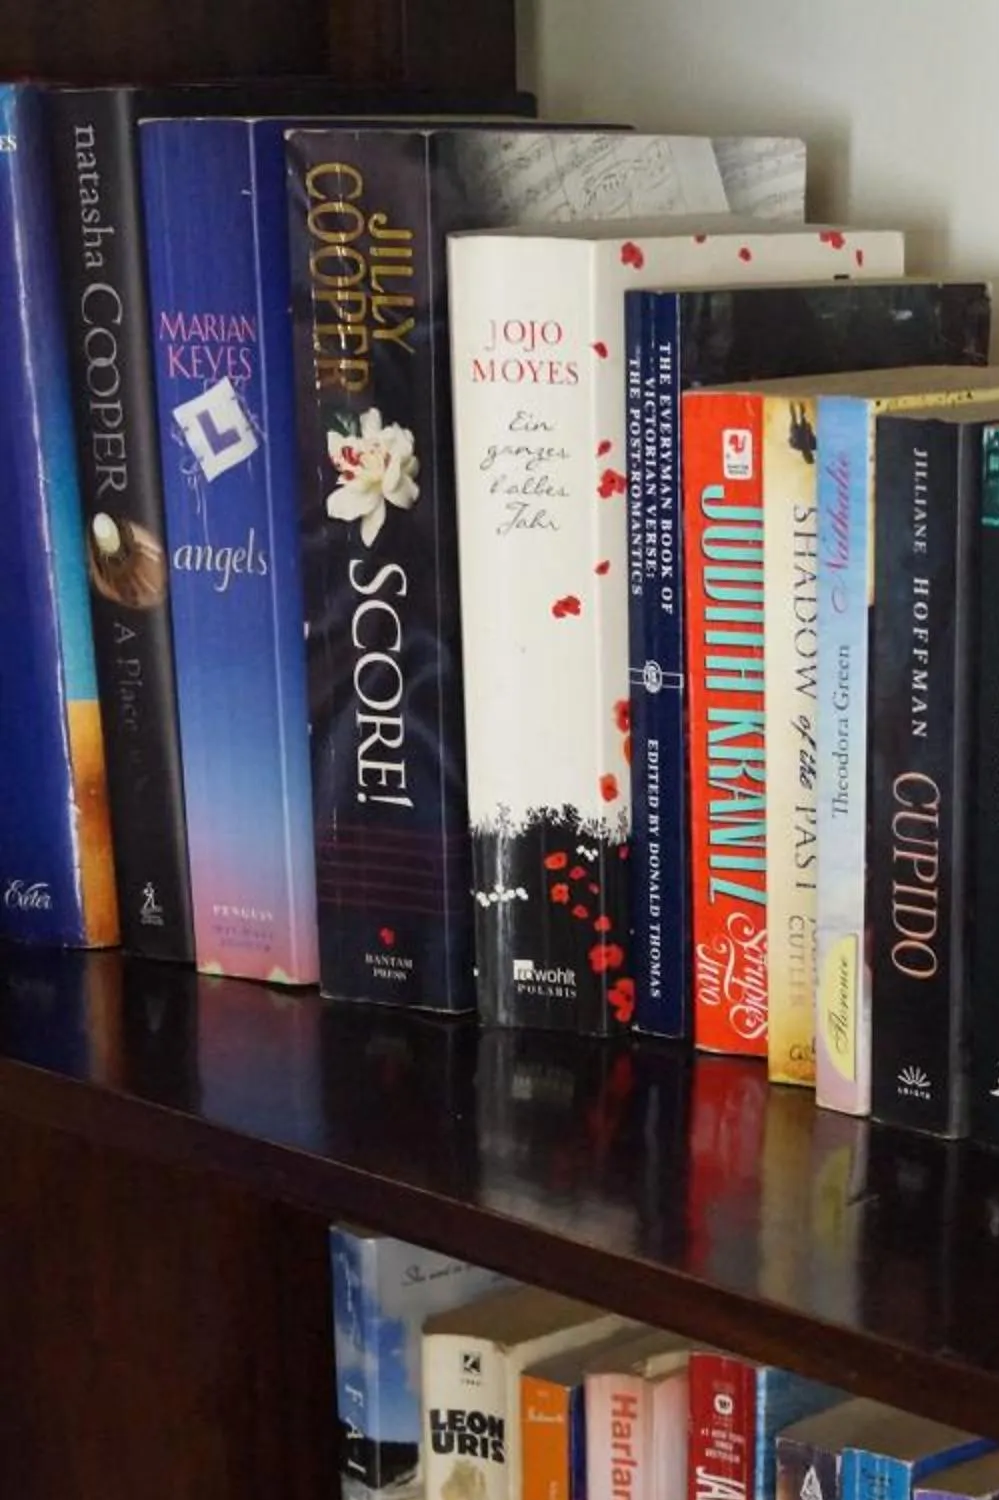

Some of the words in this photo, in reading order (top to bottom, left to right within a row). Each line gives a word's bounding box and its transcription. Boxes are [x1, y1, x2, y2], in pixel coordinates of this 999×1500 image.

[75, 124, 115, 268] natasha
[306, 163, 370, 392] COOPER
[368, 212, 415, 354] JILLY
[159, 311, 256, 343] MARIAN
[486, 320, 562, 351] JOJO
[81, 283, 128, 491] COOPER
[168, 346, 252, 380] KEYES
[472, 357, 579, 387] MOYES
[629, 357, 641, 397] THE
[660, 342, 672, 385] THE
[509, 411, 557, 433] Ein
[645, 378, 657, 496] VICTORIAN
[660, 394, 672, 513] EVERYMAN
[497, 503, 561, 534] Jahr
[629, 405, 643, 596] POST-ROMANTICS
[913, 447, 928, 554] JILLIANE
[173, 528, 267, 591] angels
[645, 504, 657, 579] VERSE:
[660, 519, 673, 578] BOOK
[661, 587, 674, 614] OF
[349, 560, 414, 808] SCORE!
[912, 578, 929, 738] HOFFMAN
[646, 739, 659, 804] EDITED
[832, 713, 850, 818] Theodora
[647, 813, 660, 835] BY
[648, 843, 661, 917] DONALD
[891, 771, 941, 980] CUPIDO
[649, 921, 662, 998] THOMAS
[430, 1408, 506, 1438] LEON
[431, 1433, 505, 1463] URIS
